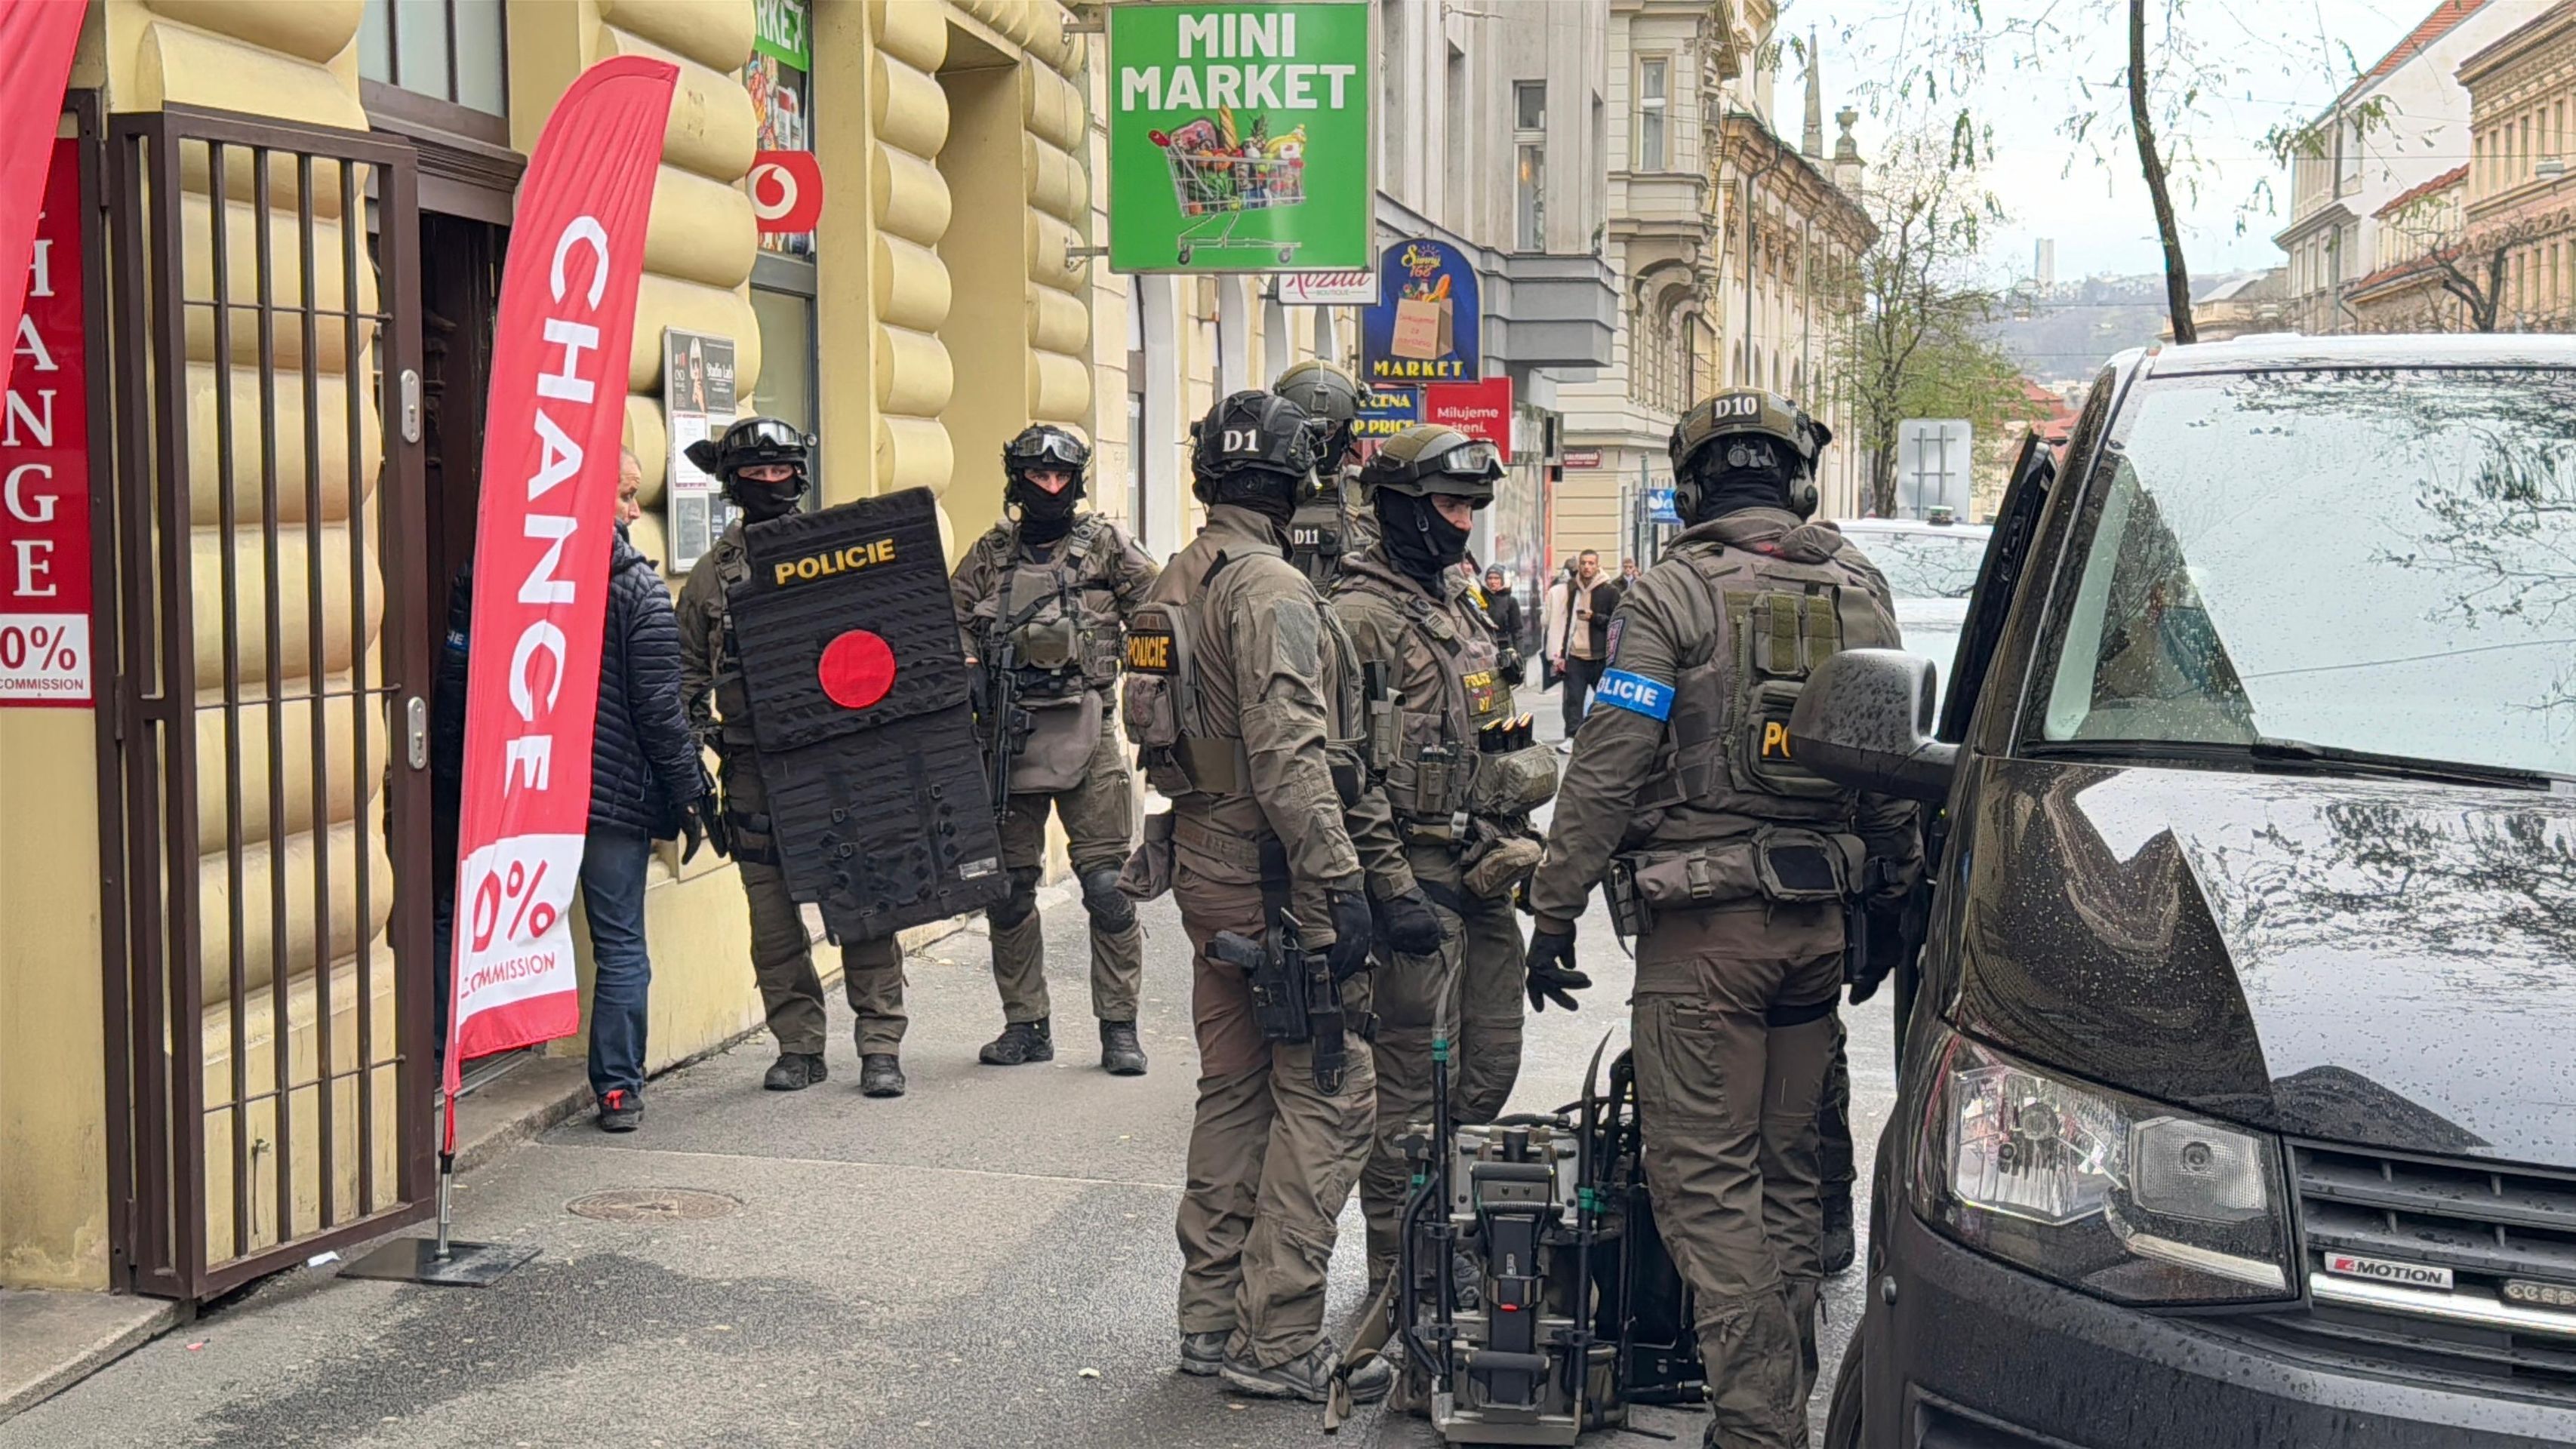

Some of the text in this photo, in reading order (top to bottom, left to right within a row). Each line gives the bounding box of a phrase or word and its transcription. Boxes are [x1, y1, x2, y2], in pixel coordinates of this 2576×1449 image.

[1178, 13, 1295, 58] MINI
[1122, 64, 1356, 111] MARKET
[1374, 360, 1463, 377] MARKET
[1437, 406, 1498, 420] Milujeme
[1715, 397, 1758, 419] D10
[1223, 429, 1260, 452] D1
[1294, 529, 1320, 545] D11
[774, 538, 896, 585] POLICIE
[0, 626, 77, 671] 0%
[1127, 636, 1170, 668] POLICIE
[472, 859, 556, 953] 0%
